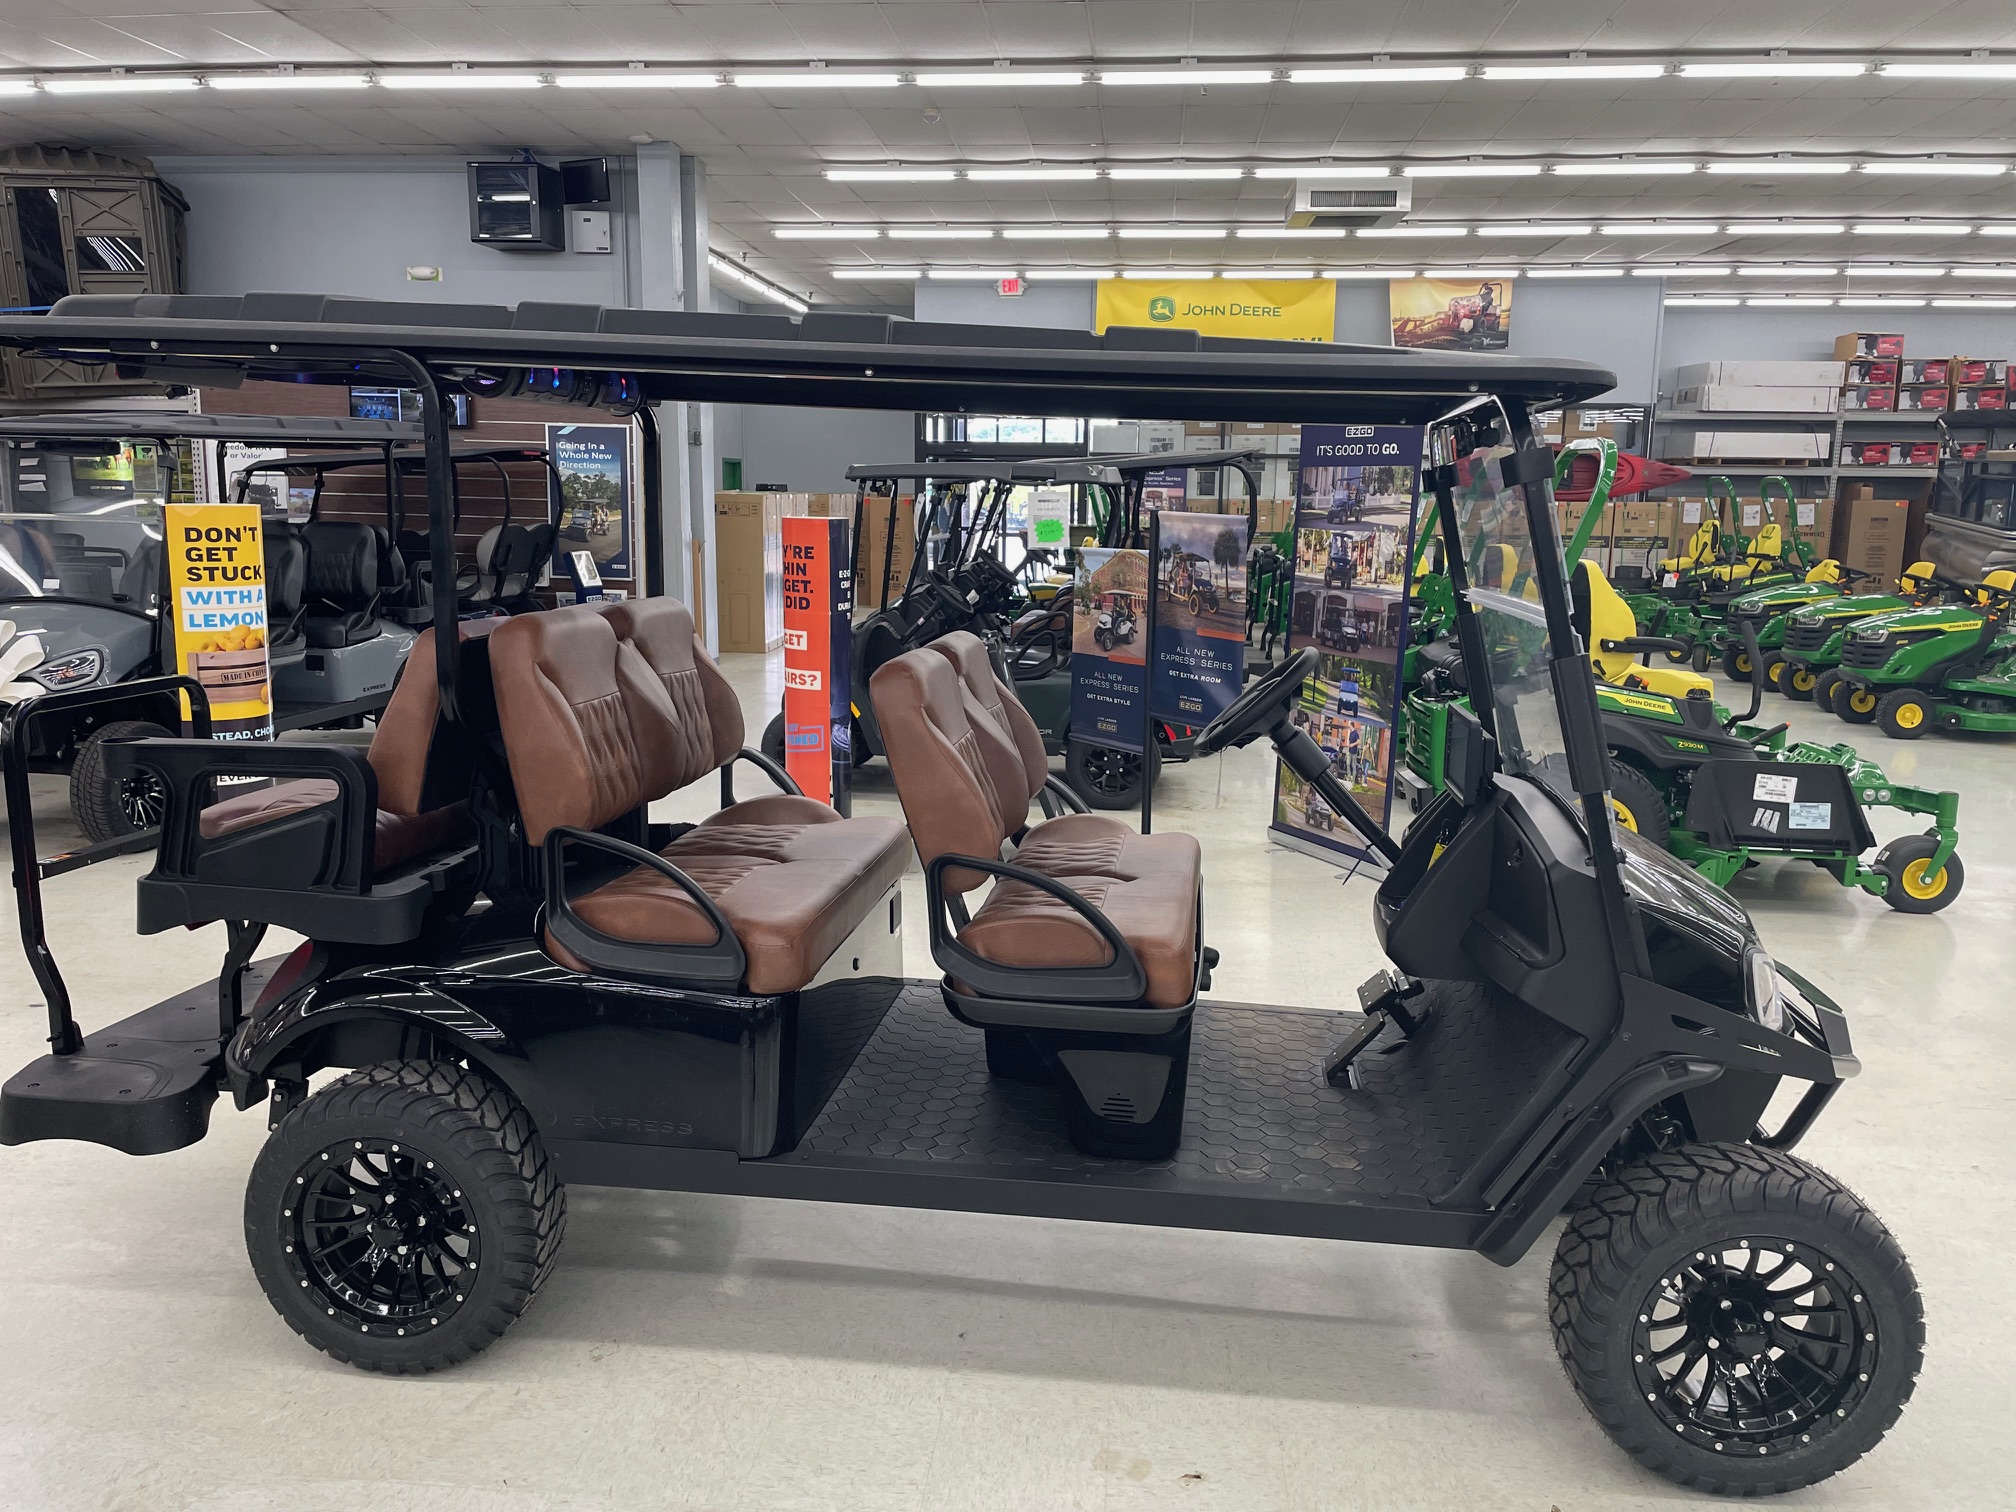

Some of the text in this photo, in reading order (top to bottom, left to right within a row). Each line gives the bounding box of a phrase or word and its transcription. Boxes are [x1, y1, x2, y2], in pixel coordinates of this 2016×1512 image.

[1002, 279, 1019, 293] EXIT
[1181, 302, 1282, 317] JOHN DEERE
[1346, 427, 1373, 436] EZGO
[558, 441, 586, 451] Going
[587, 441, 597, 450] In
[1316, 443, 1400, 457] IT'S GOOD TO GO.
[559, 450, 613, 460] Whole New
[559, 461, 601, 469] Direction
[184, 525, 258, 543] DON'T
[185, 546, 238, 563] GET
[186, 564, 263, 582] STUCK
[186, 587, 264, 606] WITH A
[785, 595, 811, 611] DID
[188, 611, 264, 628] LEMON
[1176, 645, 1215, 658] ALL NEW
[1160, 652, 1233, 671] EXPRESS SERIES
[223, 672, 243, 682] MADE
[1094, 670, 1123, 682] ALL NEW
[1168, 669, 1222, 684] GET EXTRA ROOM
[362, 683, 387, 693] EXPRESS
[1080, 677, 1139, 694] EXPRESS SERIES
[1097, 694, 1113, 703] EXTRA
[1113, 698, 1131, 706] STYLE
[1180, 701, 1202, 712] EZGO
[1624, 697, 1667, 711] JOHN DEERE
[571, 1114, 693, 1135] EXPRESS
